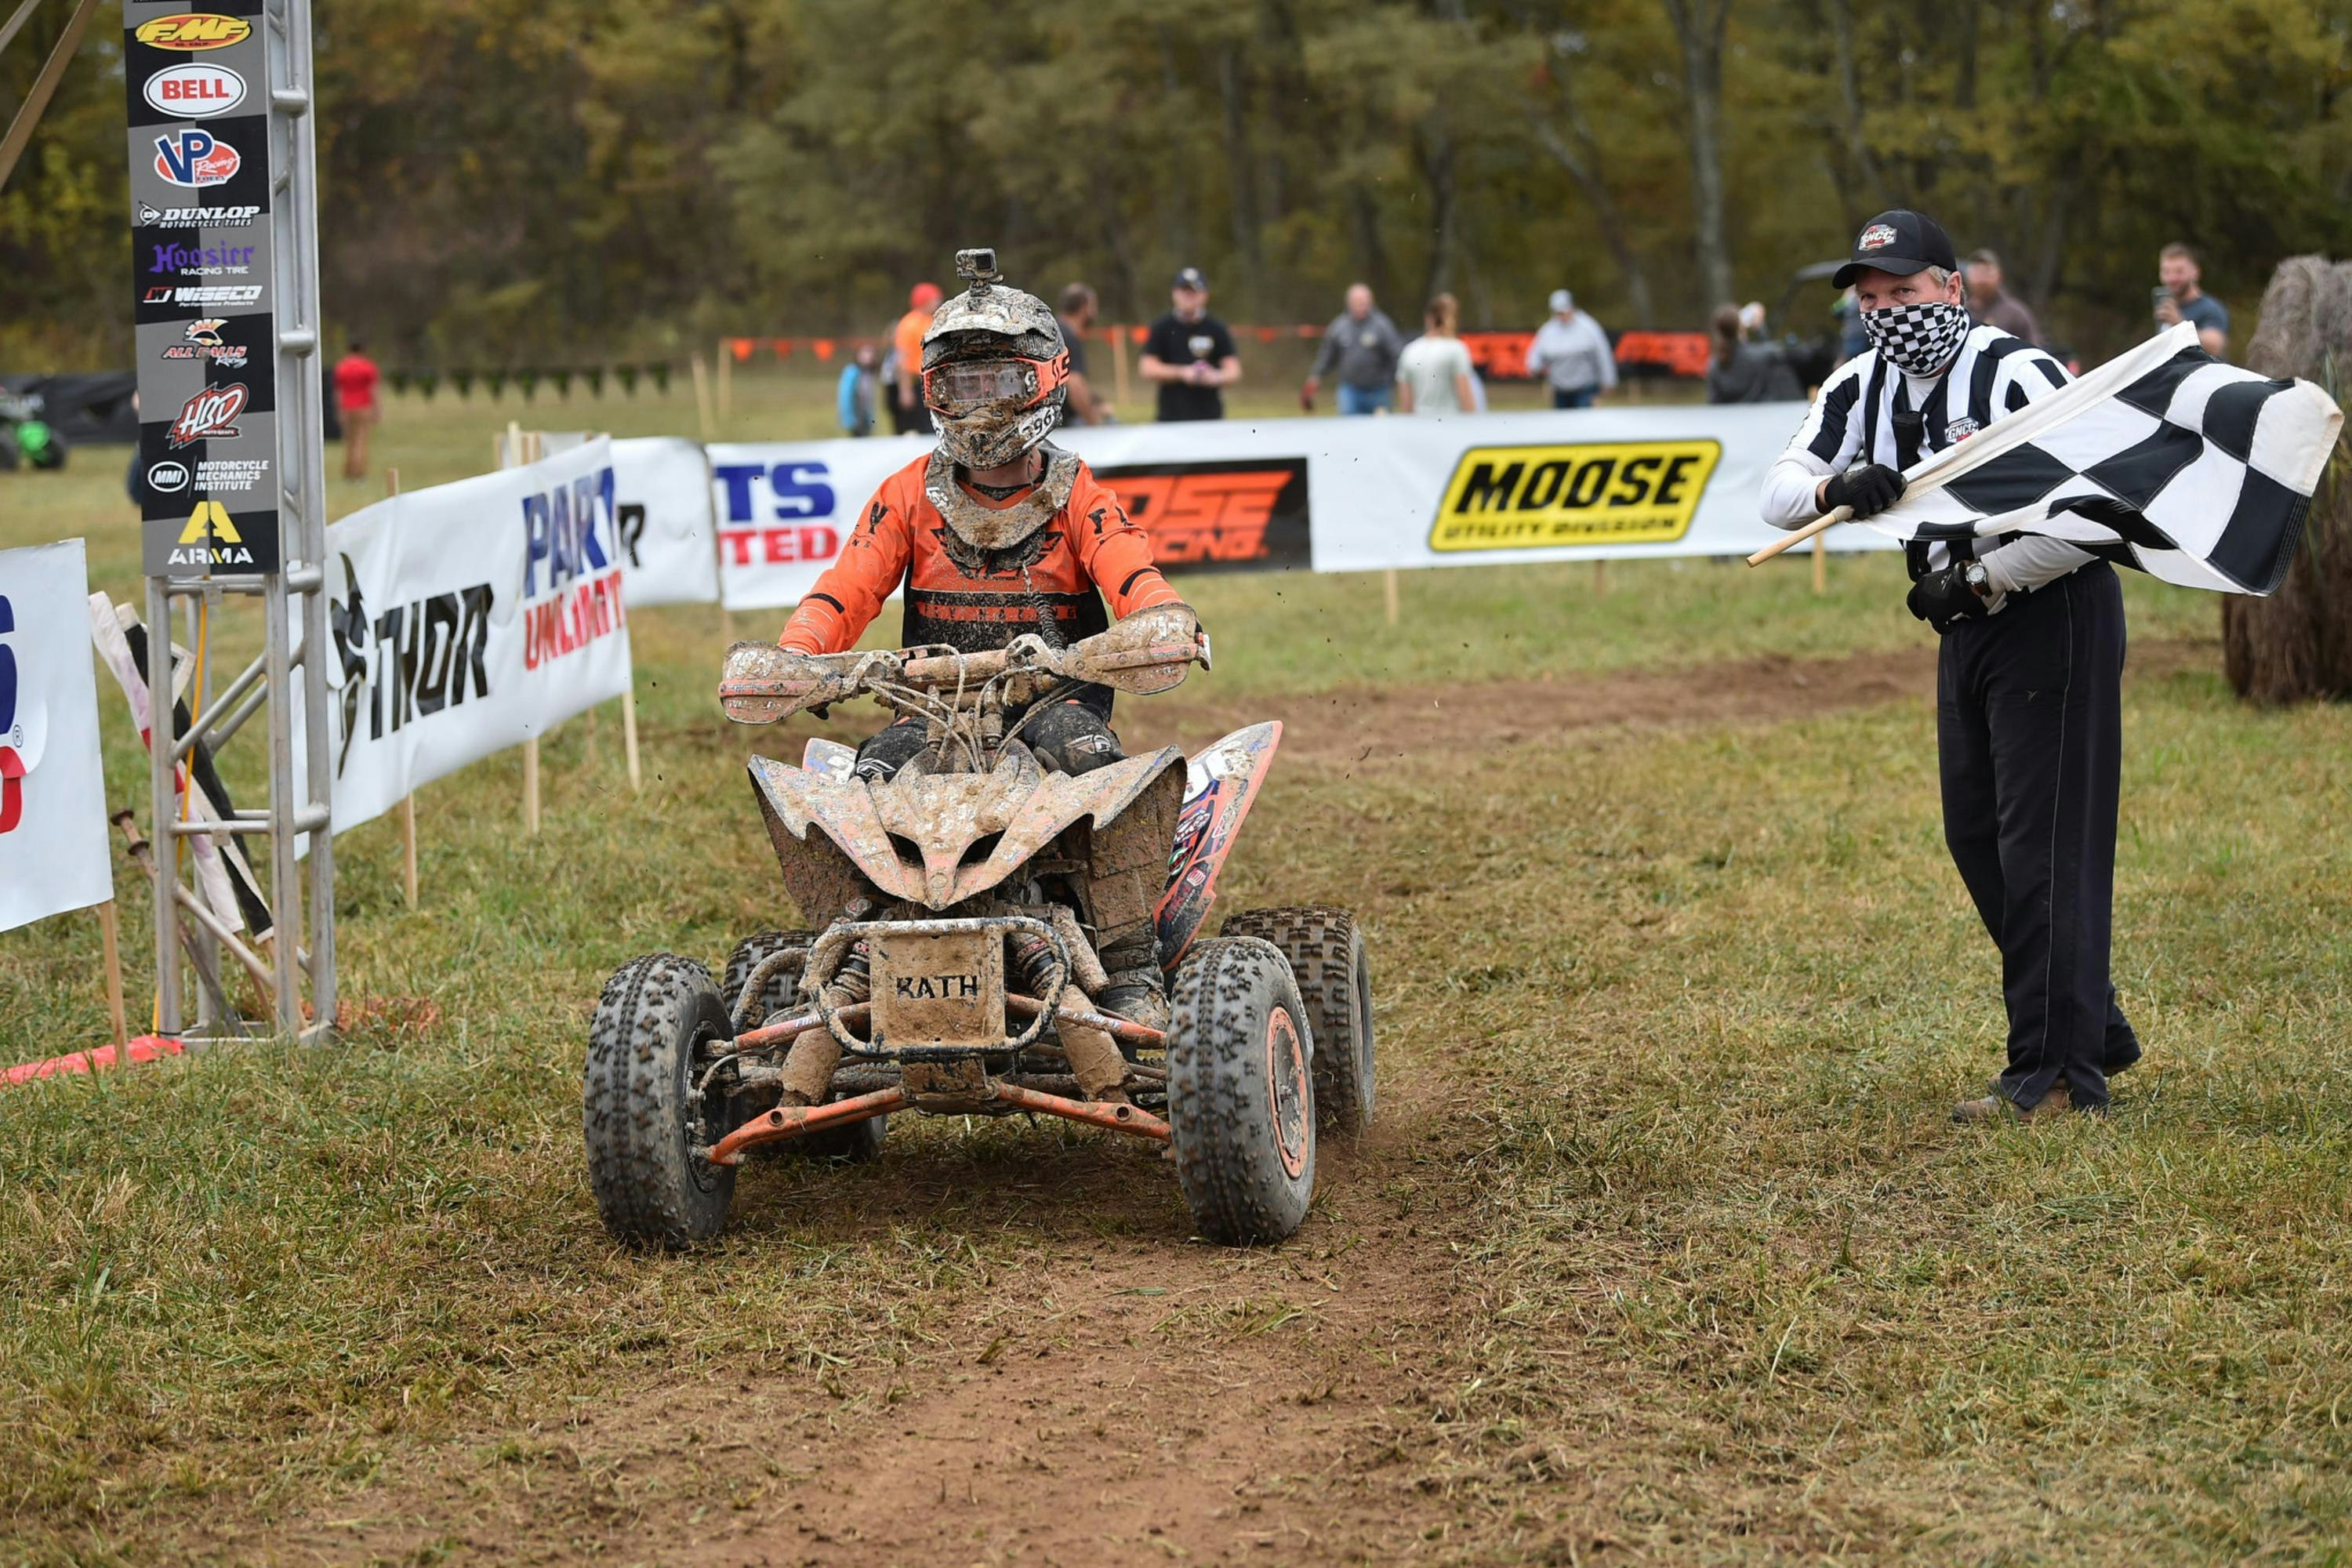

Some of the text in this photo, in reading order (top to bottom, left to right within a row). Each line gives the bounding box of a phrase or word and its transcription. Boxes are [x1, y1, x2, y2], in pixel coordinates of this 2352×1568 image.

[138, 17, 249, 42] FMF
[162, 79, 229, 100] BELL
[157, 131, 213, 184] VP
[162, 206, 260, 220] DUNLOP
[159, 219, 252, 228] MOTORCYCLE TIRES
[149, 239, 255, 273] Hoosier
[162, 347, 194, 358] ALL
[1947, 423, 1976, 439] GNCC
[198, 460, 269, 470] MOTORCYCLE
[154, 470, 183, 484] MMI
[196, 471, 261, 481] MECHANICS
[194, 481, 252, 491] INSTITUTE
[1454, 456, 1700, 514] MOOSE
[1443, 518, 1675, 539] UTILITY DIVISION
[717, 526, 839, 565] TED
[168, 547, 253, 564] ARMA
[370, 583, 494, 741] THOR
